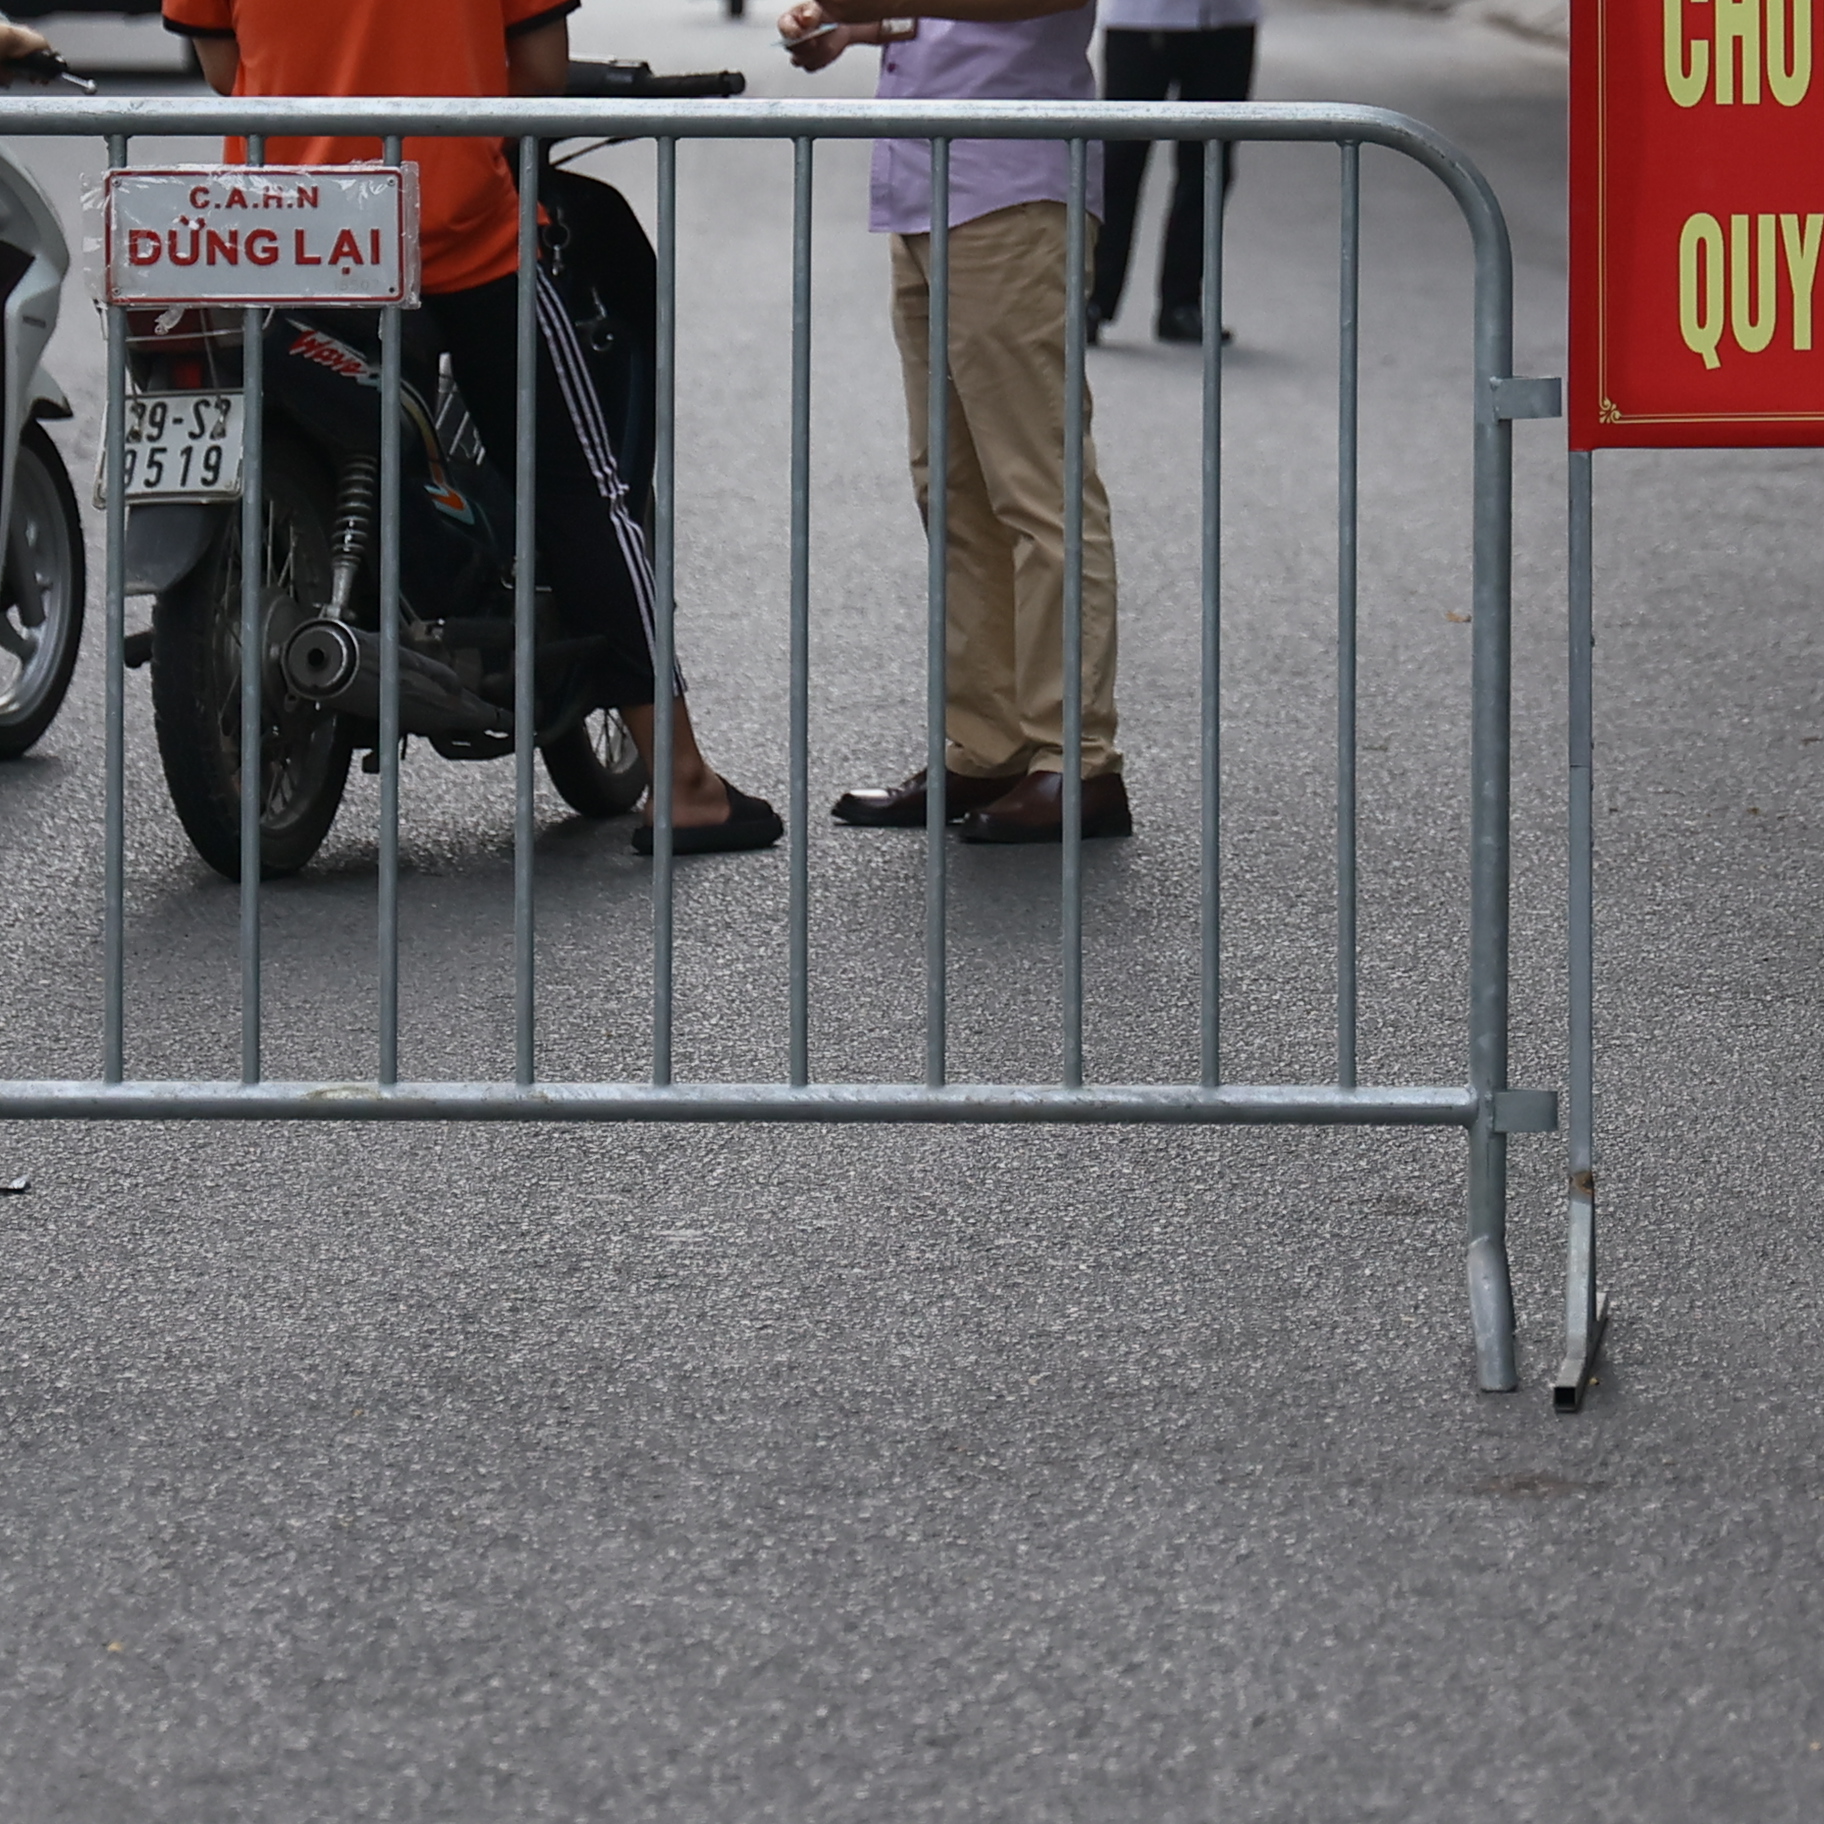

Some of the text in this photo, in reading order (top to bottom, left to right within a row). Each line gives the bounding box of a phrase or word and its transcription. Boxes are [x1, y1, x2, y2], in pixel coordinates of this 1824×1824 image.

[188, 185, 320, 210] C.A.H.N
[127, 214, 382, 276] DỪNG LẠI
[1679, 212, 1824, 370] QUY
[125, 397, 232, 444] 29-S2
[123, 445, 224, 489] 9519
